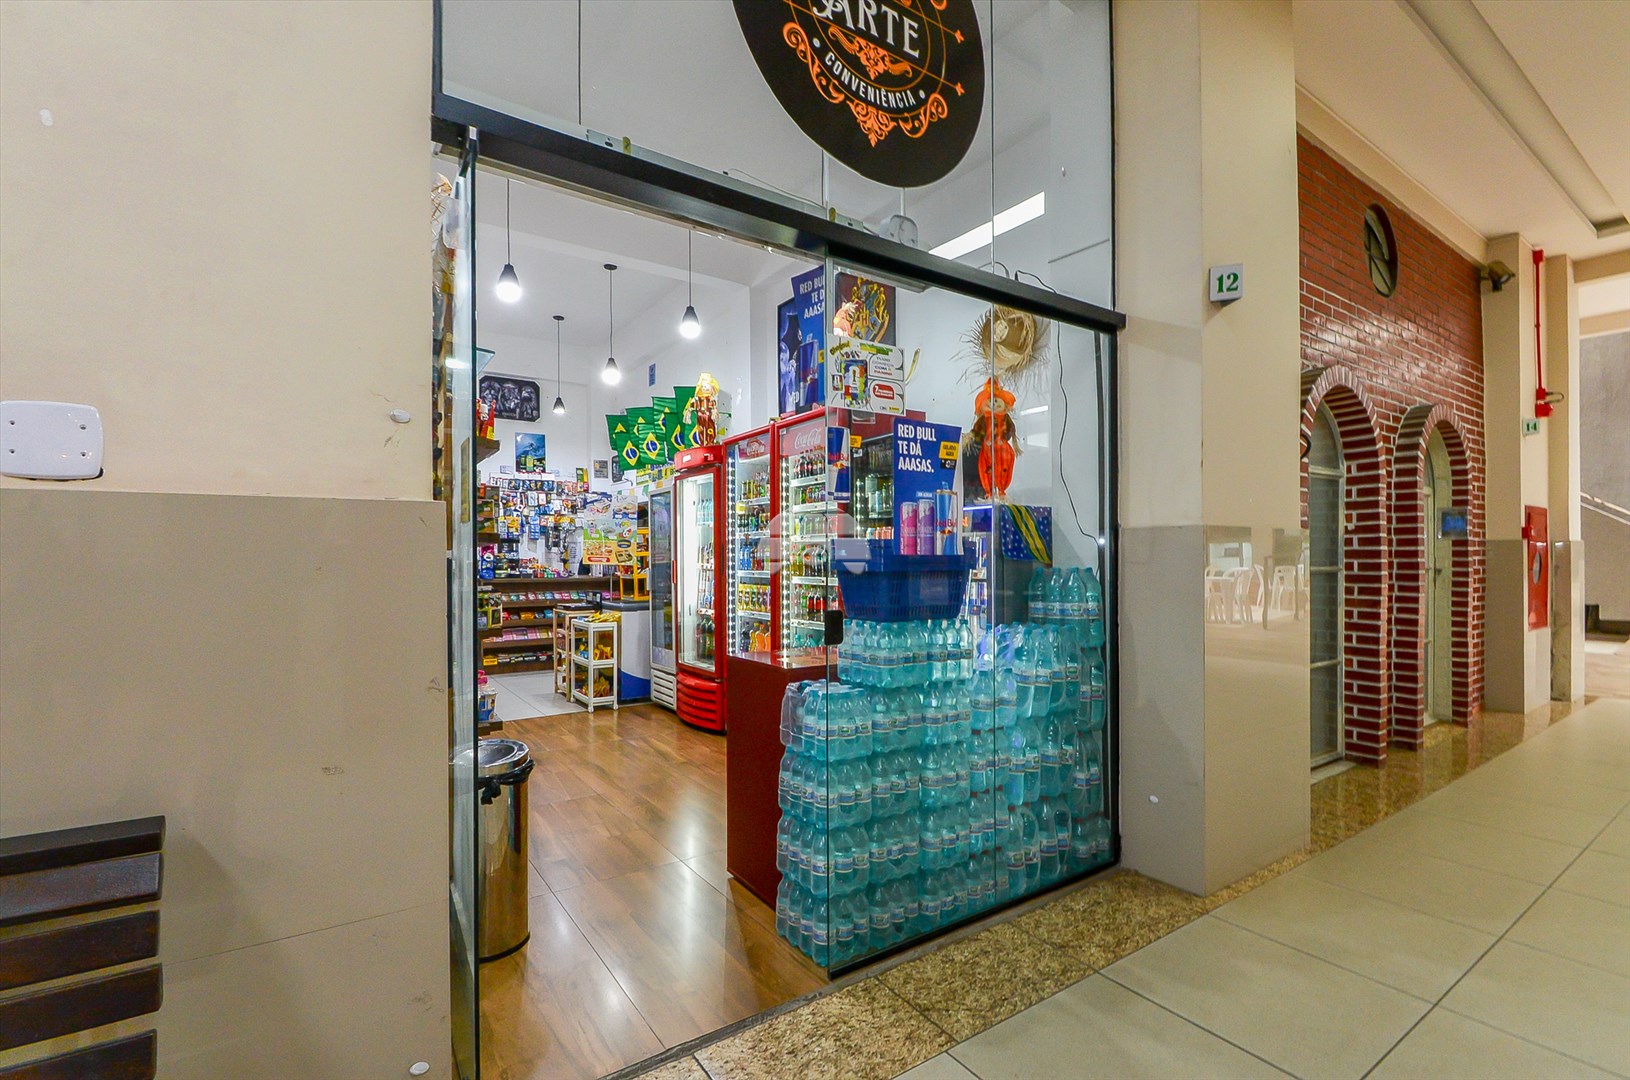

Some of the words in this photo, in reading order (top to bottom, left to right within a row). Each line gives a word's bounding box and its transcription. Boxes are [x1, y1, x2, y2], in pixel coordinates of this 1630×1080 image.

[825, 51, 916, 109] CONVENIÊNCIA
[800, 280, 812, 295] RED
[1217, 272, 1239, 294] 12
[811, 293, 818, 303] TE
[897, 424, 915, 438] RED
[916, 426, 937, 441] BULL
[1526, 422, 1537, 432] 14
[897, 440, 908, 454] TE
[909, 439, 922, 456] DÁ
[898, 456, 935, 473] AAASAS.
